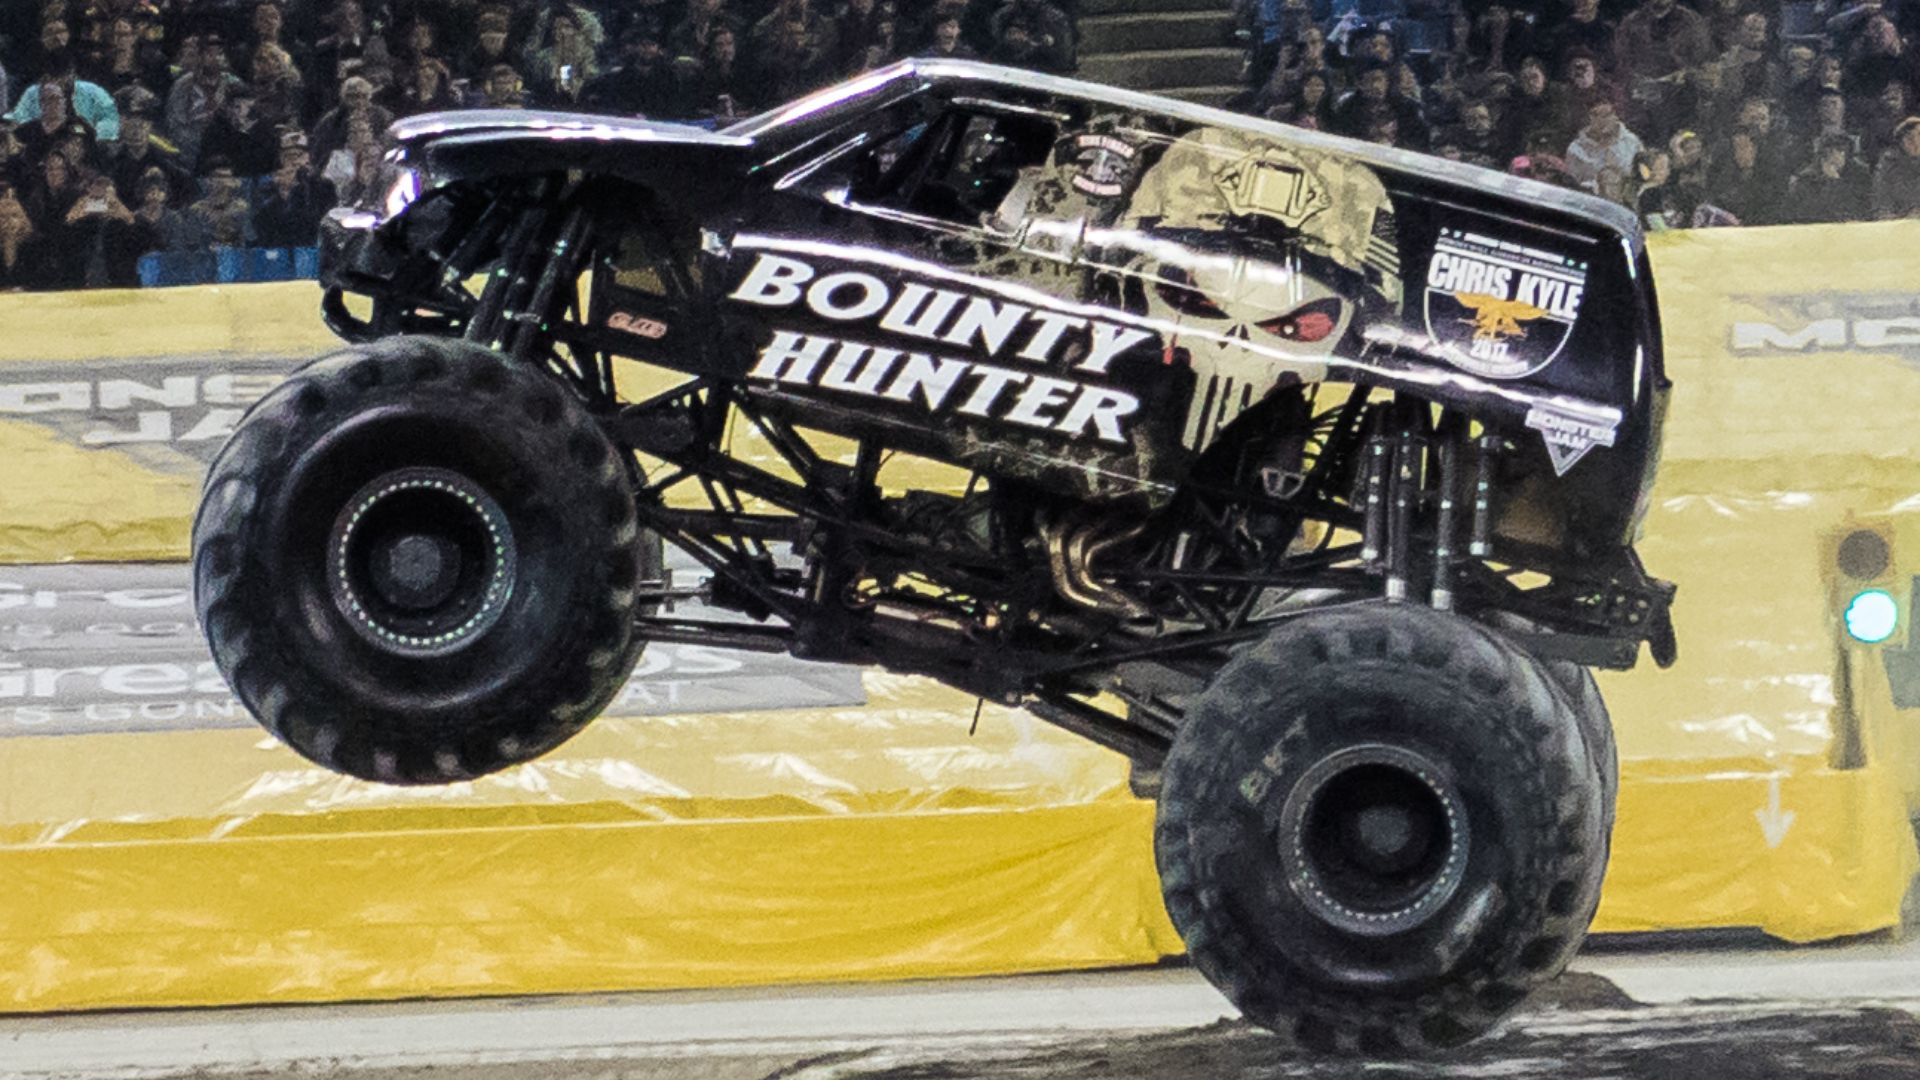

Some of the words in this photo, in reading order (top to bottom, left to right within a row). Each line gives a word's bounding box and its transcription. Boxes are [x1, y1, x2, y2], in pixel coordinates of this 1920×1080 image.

[730, 253, 1156, 374] BOUNTY
[1427, 252, 1512, 300] CHRIS
[1515, 273, 1583, 320] KYLE
[747, 330, 1140, 444] HUNTER
